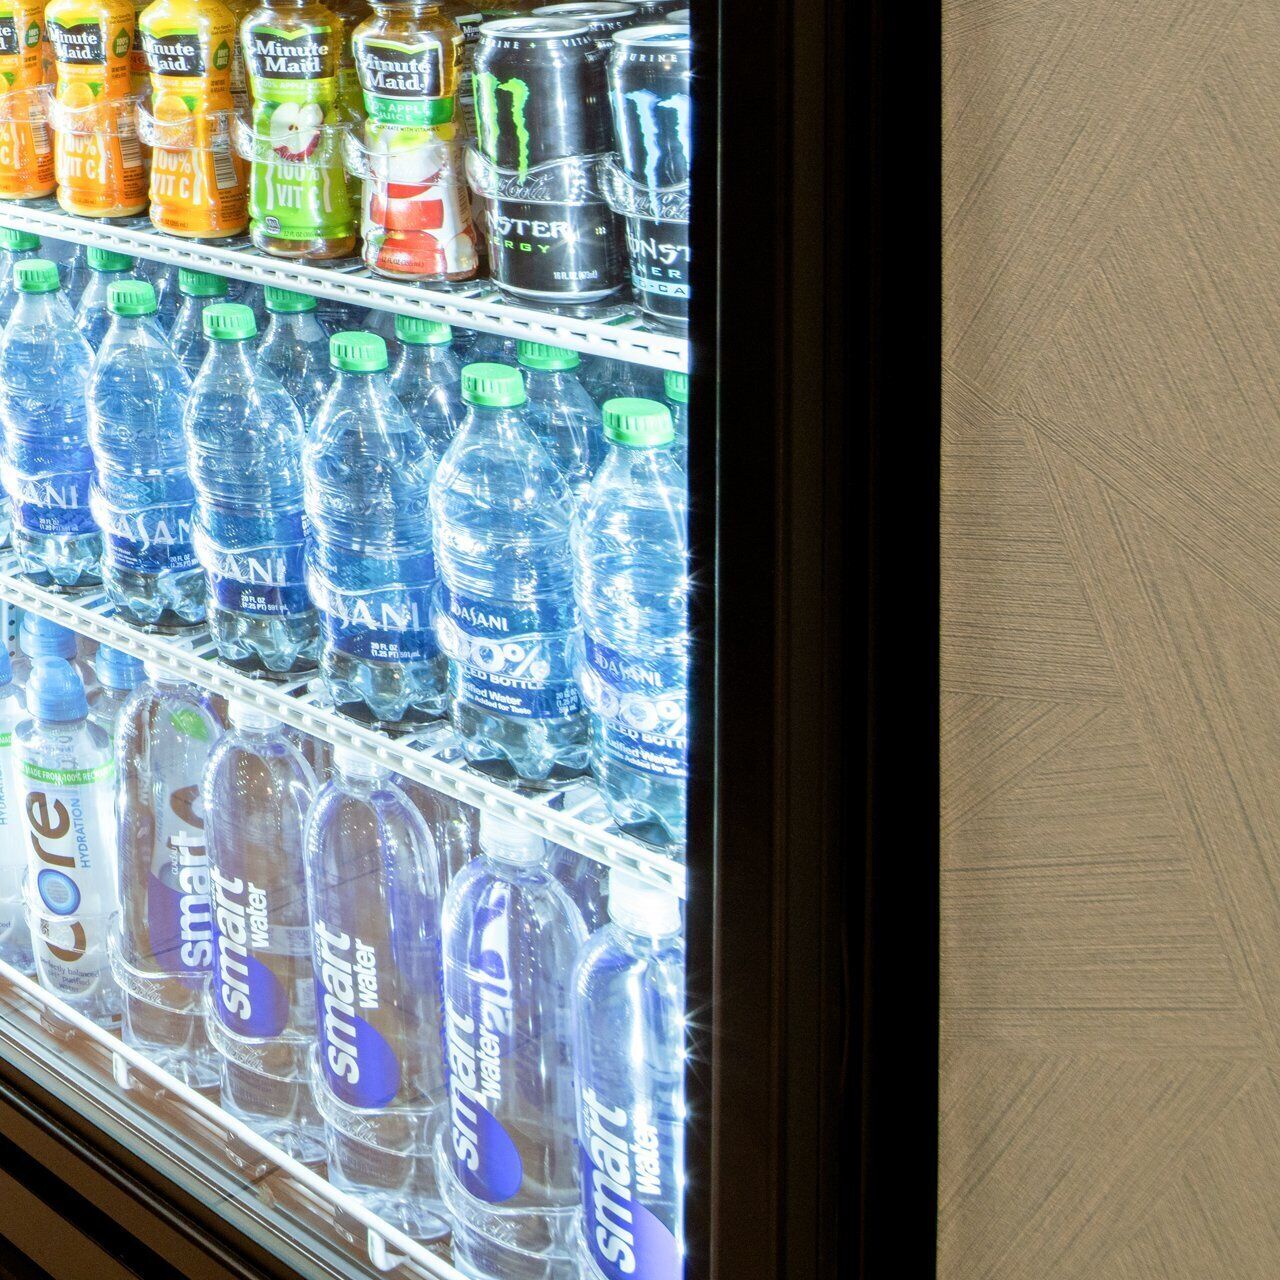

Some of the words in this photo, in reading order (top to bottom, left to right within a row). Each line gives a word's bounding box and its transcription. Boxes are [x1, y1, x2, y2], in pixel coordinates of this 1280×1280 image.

[47, 26, 98, 47] Minute
[256, 39, 329, 57] Minute
[265, 55, 323, 73] Maid
[358, 53, 432, 75] Minute
[365, 71, 427, 91] Maid
[61, 157, 82, 178] VIT
[85, 158, 96, 180] C
[152, 149, 192, 173] 100%
[151, 173, 175, 196] VIT
[179, 175, 190, 198] C
[450, 604, 510, 632] DASANI
[73, 797, 90, 869] HYDRATION
[26, 791, 87, 963] core
[170, 830, 211, 970] smart
[246, 882, 270, 949] water
[210, 865, 251, 1021] smart
[40, 956, 68, 974] perfectly
[67, 966, 99, 978] balanced
[61, 974, 89, 985] purified
[354, 937, 379, 1010] water
[314, 919, 359, 1085] smart
[447, 998, 480, 1172] smart
[476, 1022, 503, 1101] water
[635, 1113, 662, 1196] water
[583, 1087, 637, 1275] smart
